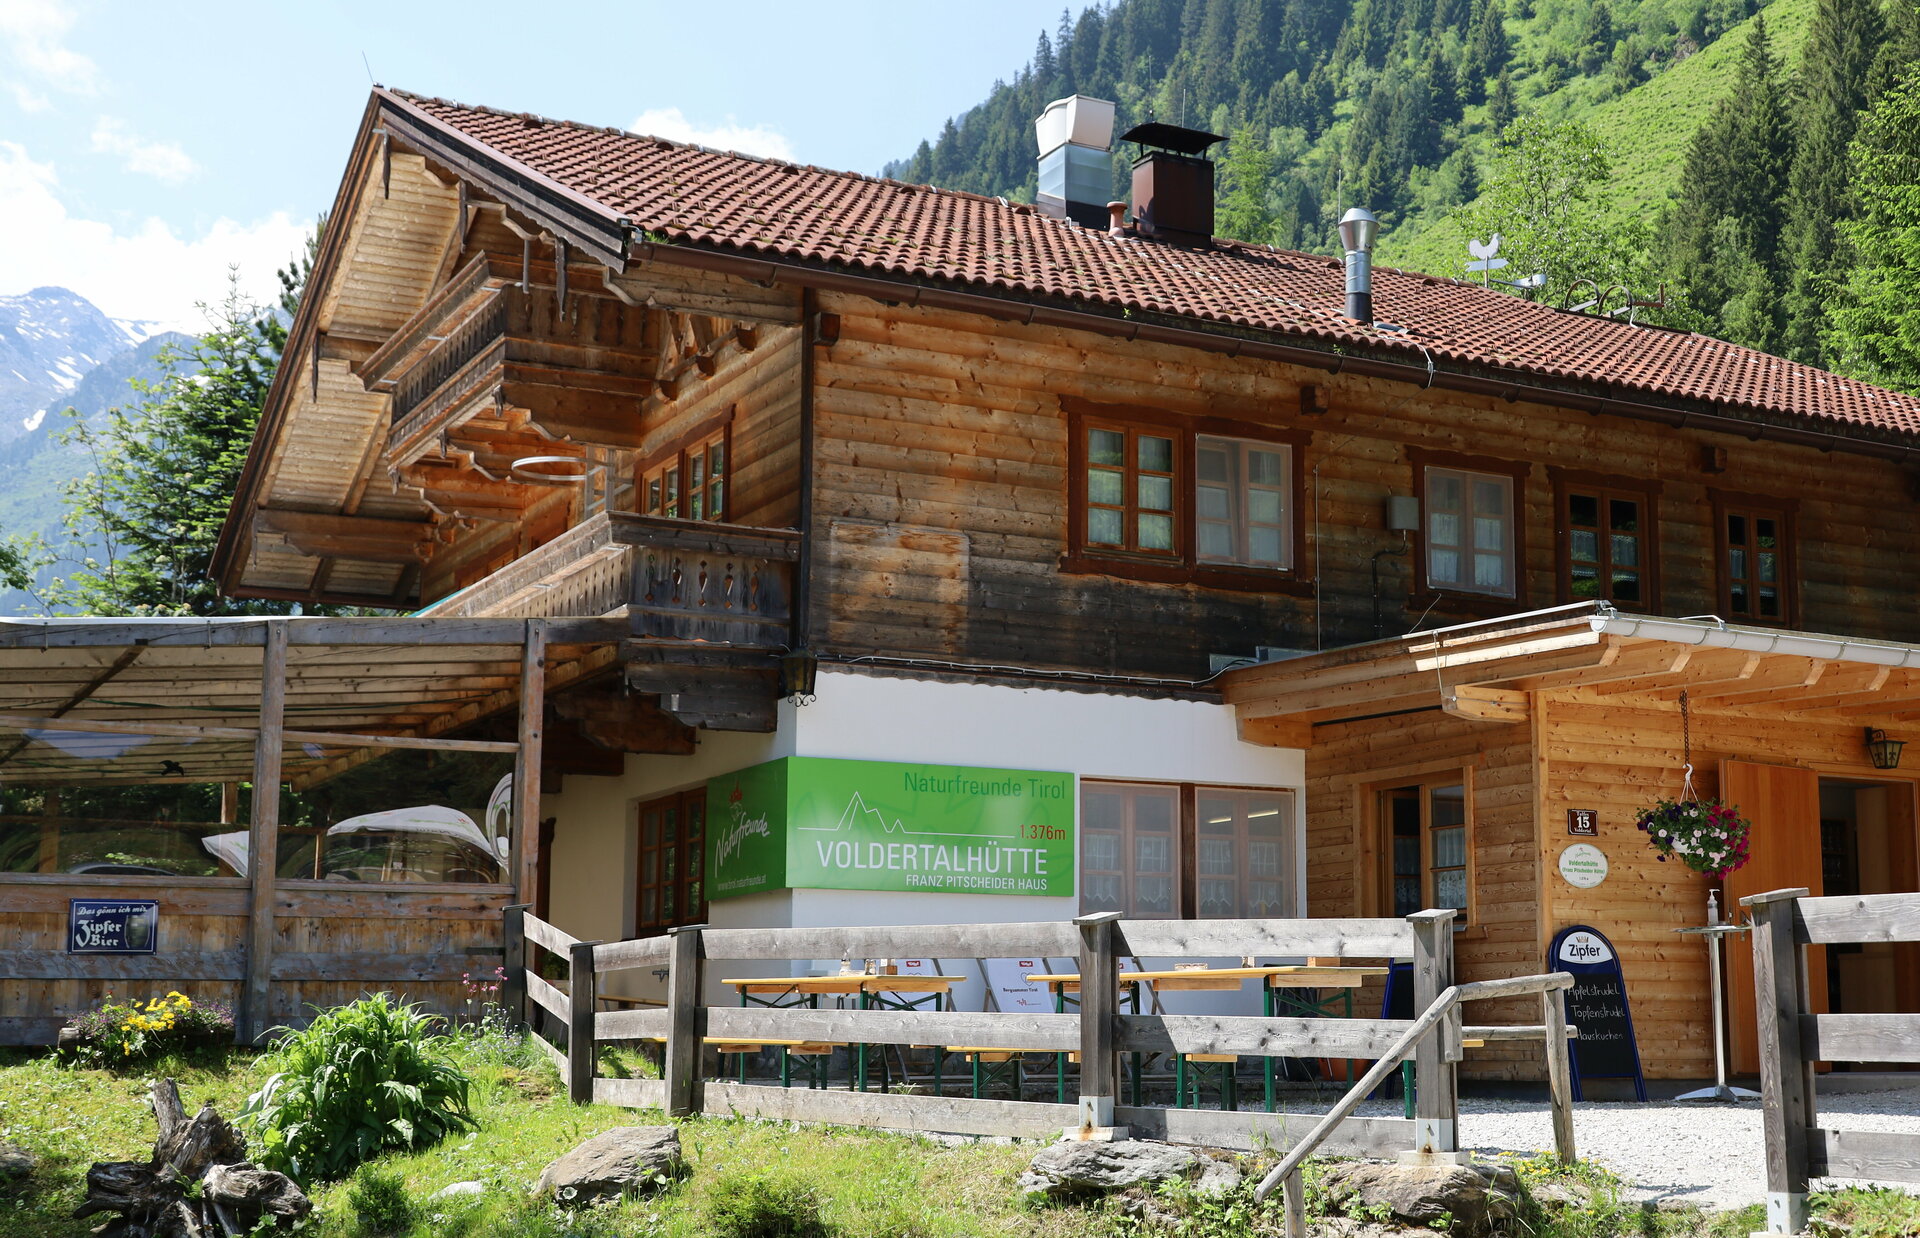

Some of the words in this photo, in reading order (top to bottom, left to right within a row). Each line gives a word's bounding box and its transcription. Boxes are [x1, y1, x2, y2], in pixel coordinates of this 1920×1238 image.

[904, 772, 1022, 797] Naturfreunde
[1028, 778, 1065, 799] Tirol
[1576, 816, 1590, 828] 15
[1020, 824, 1066, 840] 1.376m
[714, 811, 770, 879] Naturfreunde
[816, 840, 1048, 875] VOLDERTALHÜTTE
[906, 874, 943, 887] FRANZ
[946, 876, 1015, 889] PITSCHEIDER
[1018, 878, 1048, 890] HAUS
[77, 906, 95, 915] Das
[96, 906, 116, 917] gönn
[118, 905, 131, 913] ich
[75, 920, 122, 947] Zipfer
[89, 934, 119, 947] Bier
[1568, 944, 1601, 960] Zipfer
[1567, 983, 1620, 1000] Apfelstrudel
[1570, 1003, 1626, 1021] Topfenstrudel
